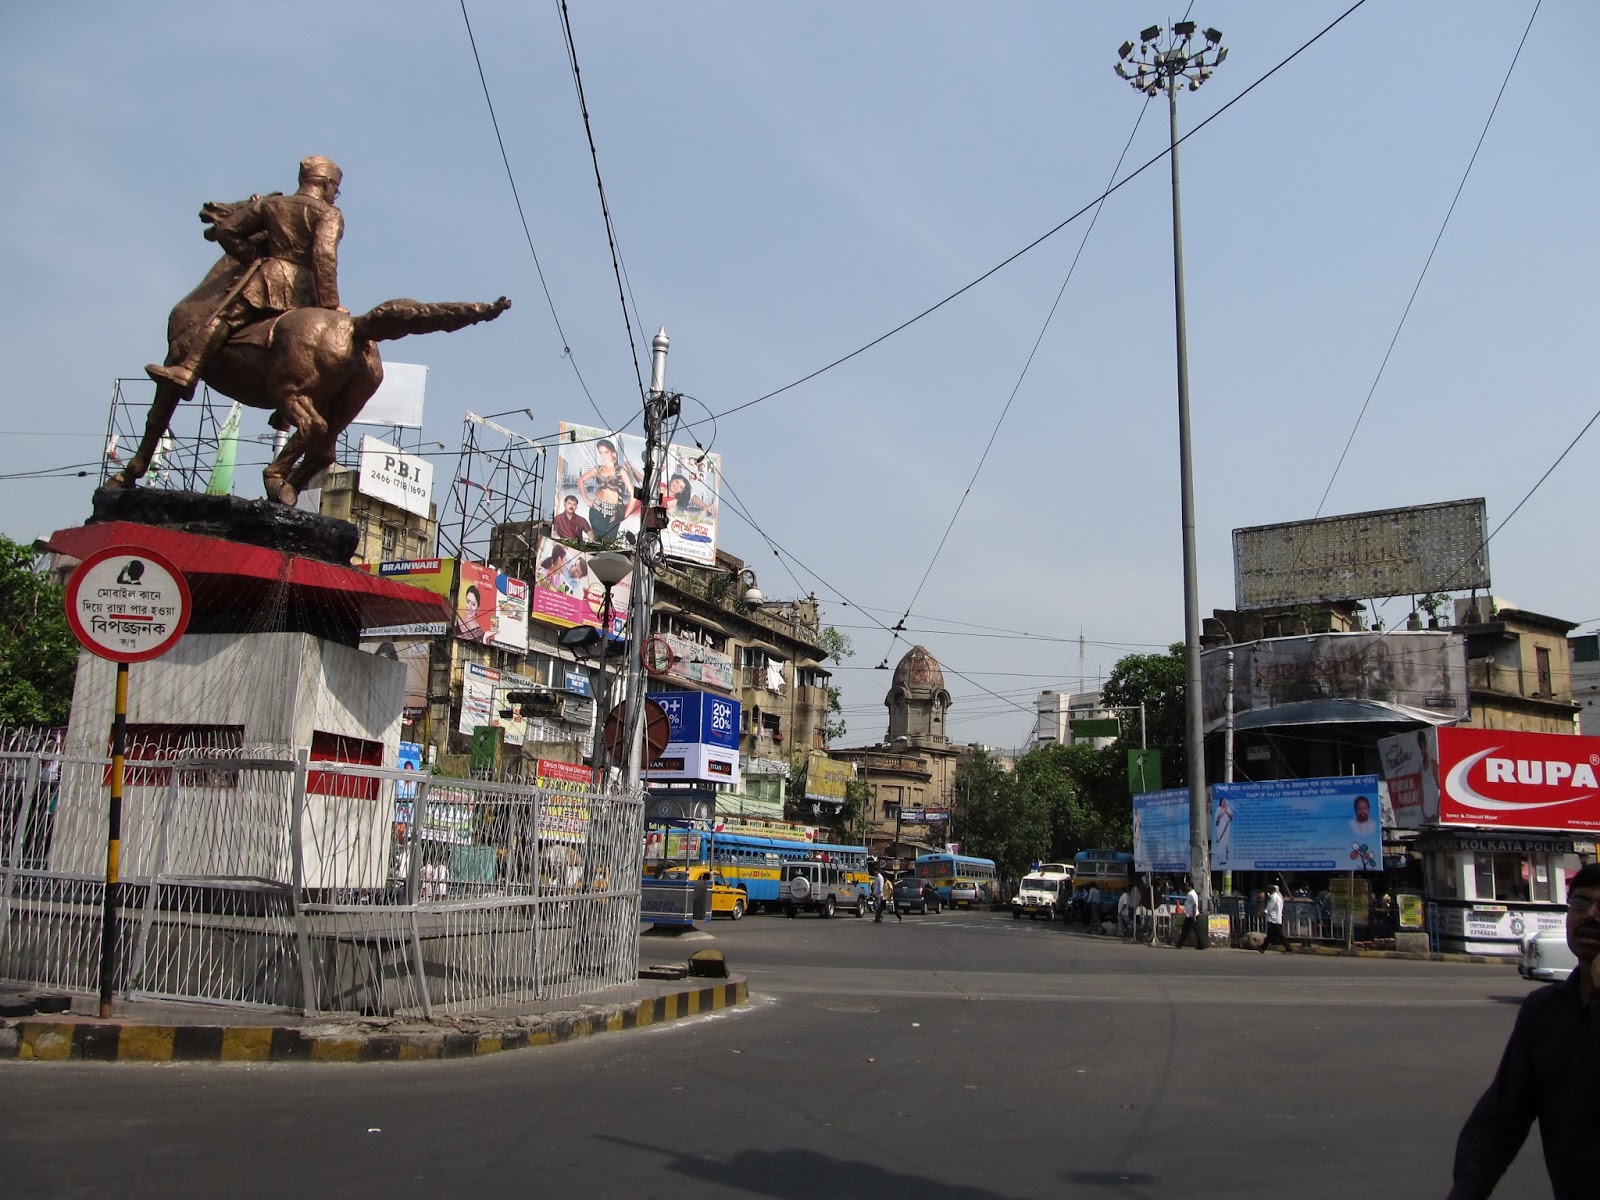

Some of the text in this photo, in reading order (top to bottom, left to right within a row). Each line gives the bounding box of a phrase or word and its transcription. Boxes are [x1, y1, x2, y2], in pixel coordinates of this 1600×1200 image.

[384, 455, 421, 483] P.B.I
[382, 561, 439, 572] BRAINWARE
[97, 588, 161, 600] মোবাইল কানে
[83, 600, 175, 616] দিয়ে রাস্তা পার হওয়া
[91, 615, 166, 636] বিপজ্জনক
[713, 703, 731, 718] 20+
[713, 715, 730, 729] 20%
[1486, 758, 1599, 788] RUPA
[1460, 839, 1522, 851] KOLKATA
[1525, 842, 1572, 853] POLICE
